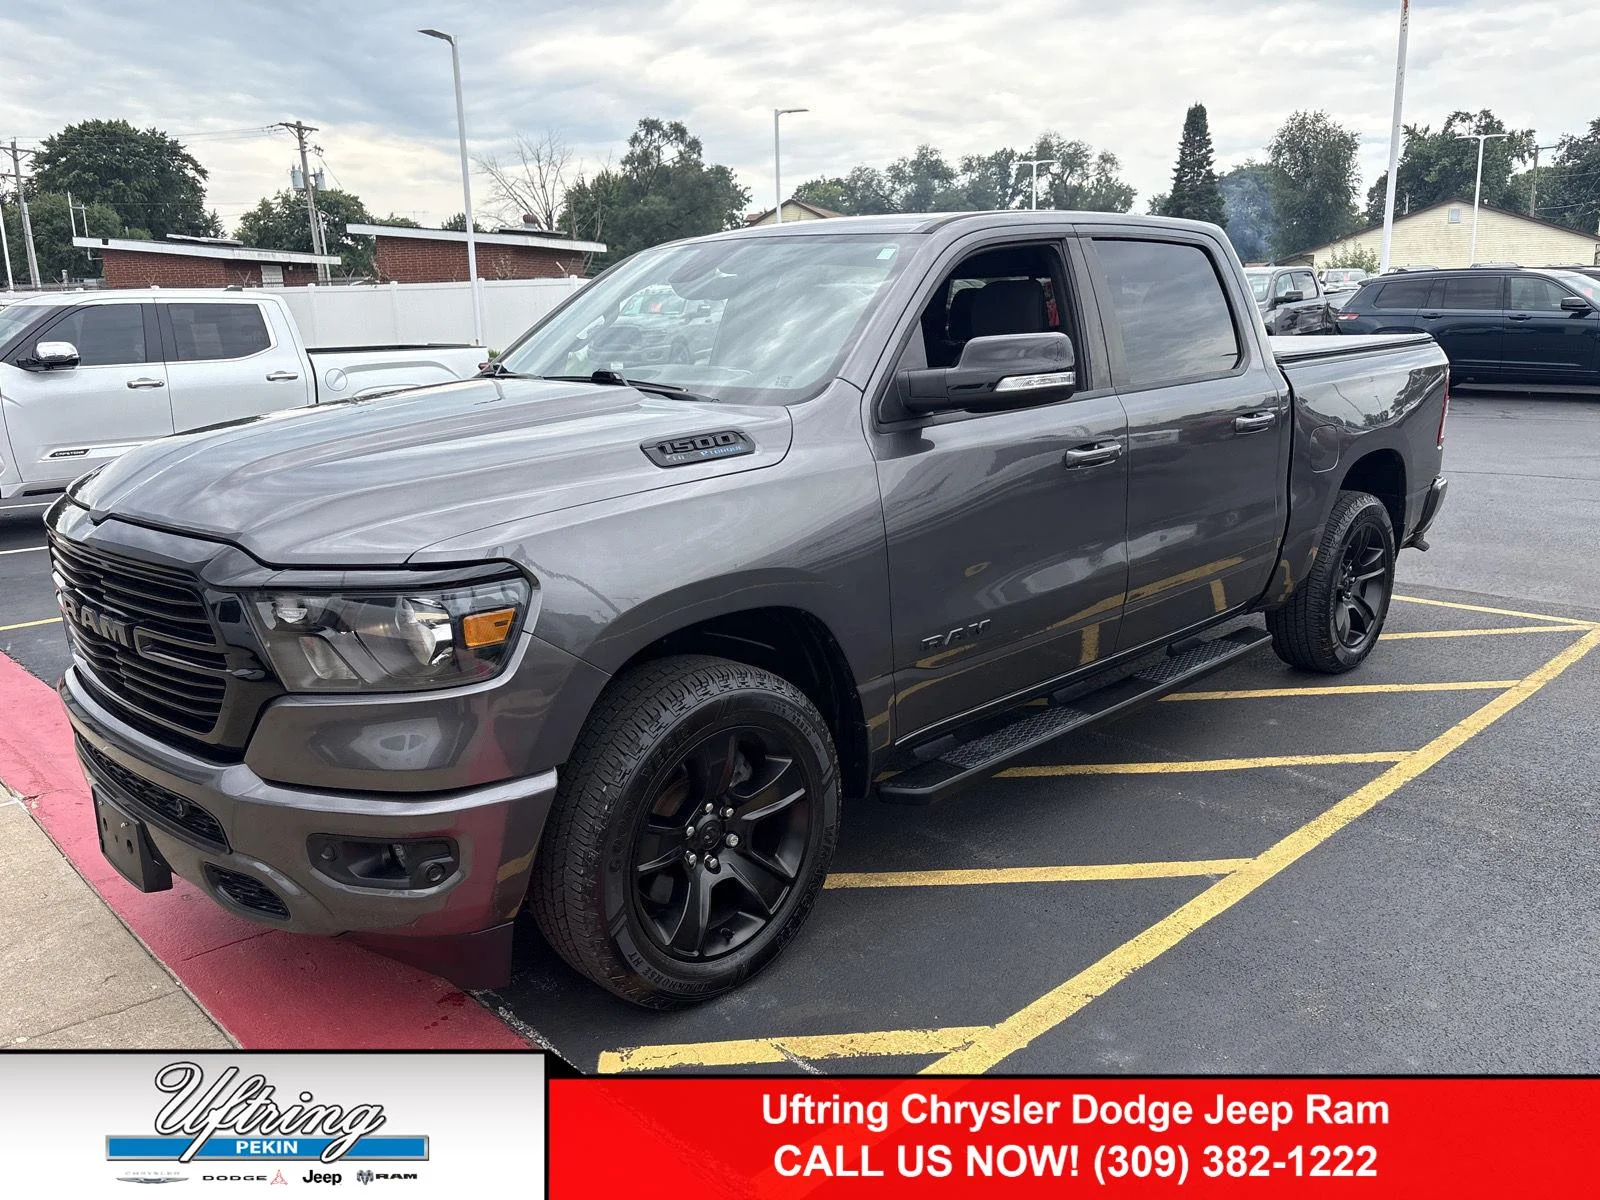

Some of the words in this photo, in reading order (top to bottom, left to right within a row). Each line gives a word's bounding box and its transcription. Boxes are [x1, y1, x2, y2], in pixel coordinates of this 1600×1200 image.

[657, 432, 736, 455] 1500
[61, 591, 131, 649] RAM
[920, 618, 991, 650] RAM
